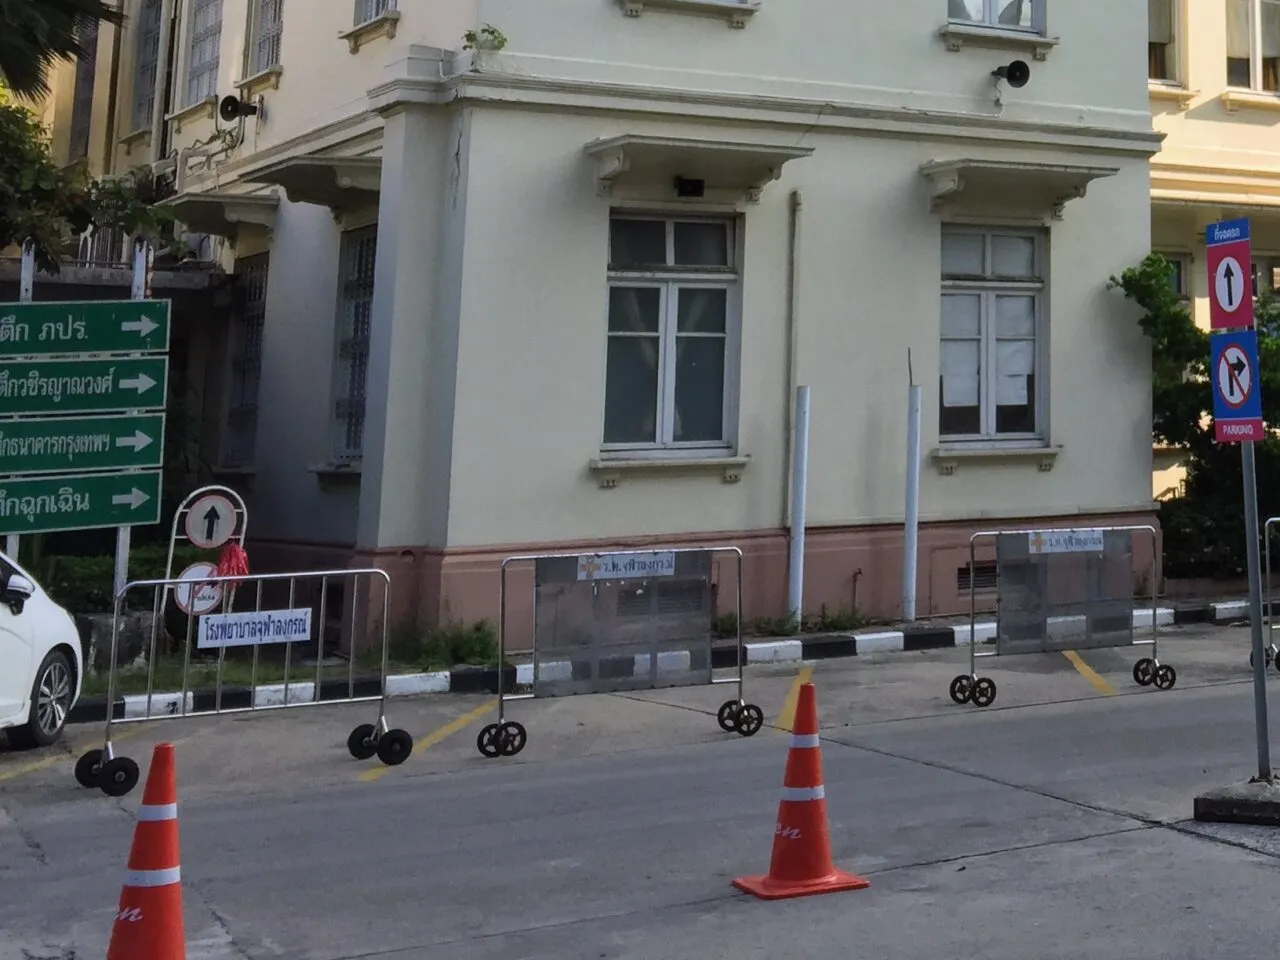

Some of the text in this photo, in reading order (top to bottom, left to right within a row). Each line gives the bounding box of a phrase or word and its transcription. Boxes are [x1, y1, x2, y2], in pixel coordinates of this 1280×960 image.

[0, 315, 29, 341] ตึก
[1222, 424, 1254, 436] PARKING
[204, 611, 309, 642] โรงพยาบาลจุฬาลงกรณ์
